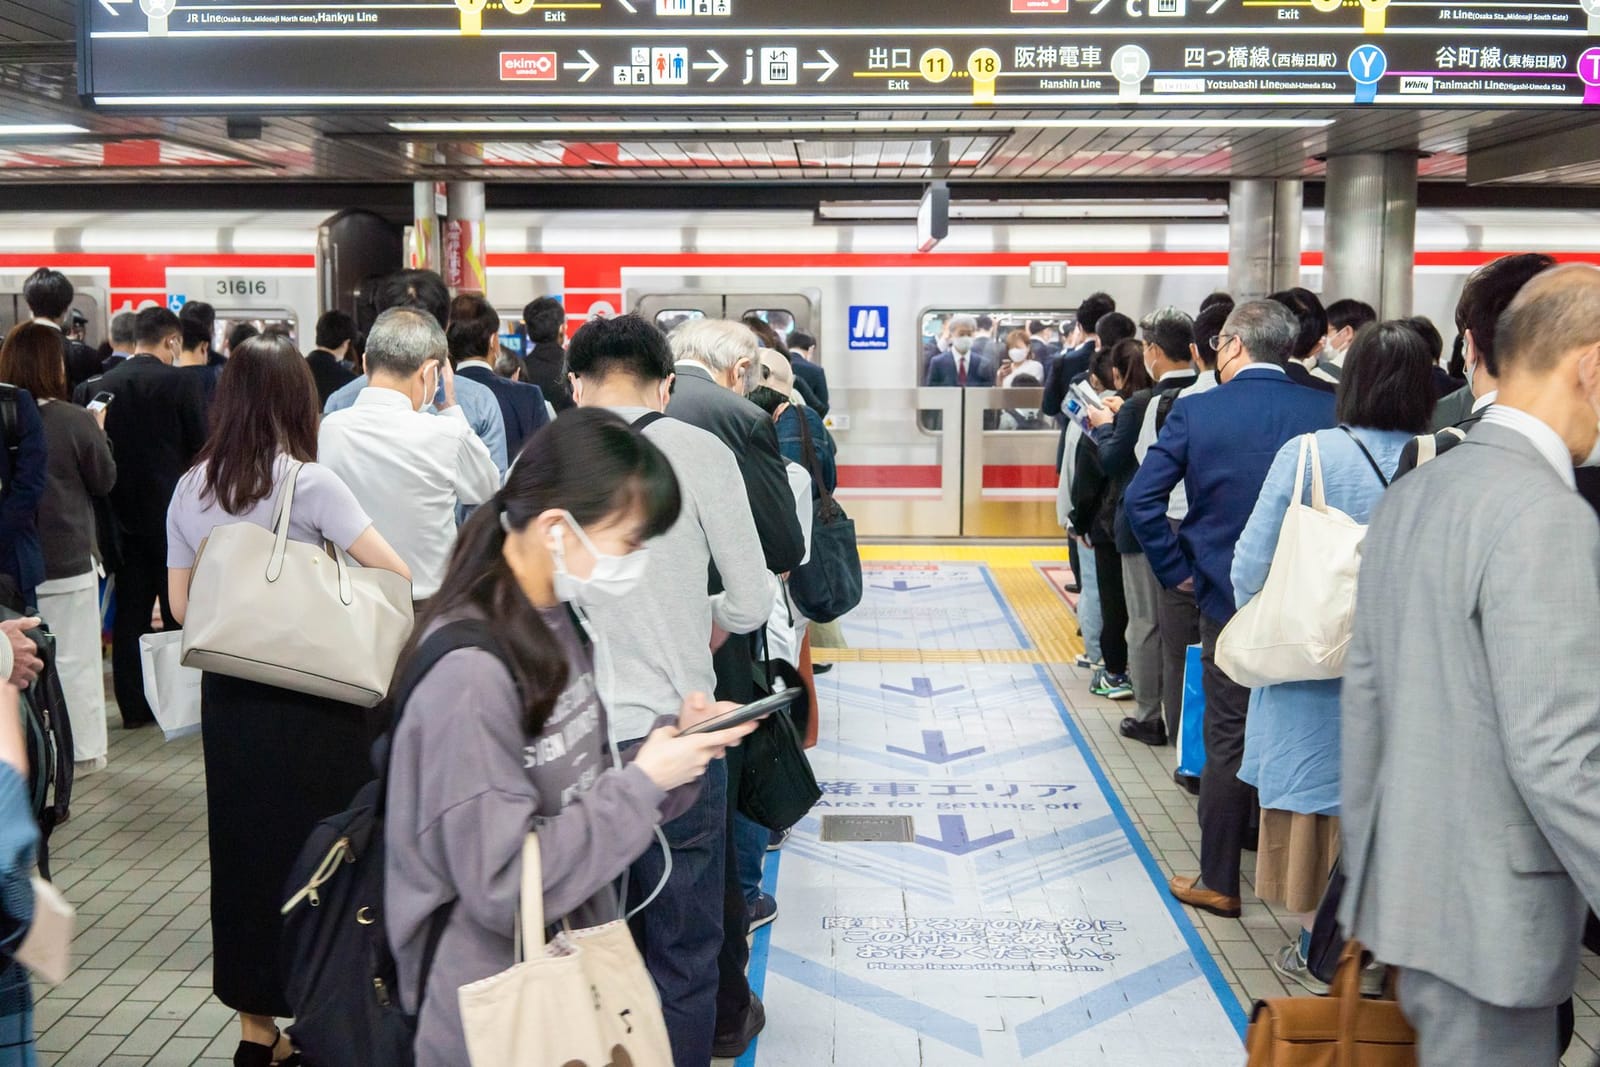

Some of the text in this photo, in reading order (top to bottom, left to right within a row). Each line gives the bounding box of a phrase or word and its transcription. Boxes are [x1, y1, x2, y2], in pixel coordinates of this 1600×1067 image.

[186, 13, 199, 23] JR
[280, 15, 299, 23] North
[356, 12, 378, 22] Line
[544, 11, 567, 22] Exit
[1277, 9, 1299, 20] Exit
[1438, 9, 1451, 19] JR
[1534, 13, 1551, 21] South
[868, 47, 911, 69] 出口
[1014, 46, 1102, 68] 阪神電車
[926, 58, 945, 73] 11
[974, 58, 994, 73] 18
[1358, 51, 1377, 78] Y
[887, 79, 909, 90] Exit
[1040, 79, 1101, 89] Hanshin Line
[1206, 79, 1258, 90] Yotsubashi
[1404, 80, 1429, 91] Whity
[1434, 79, 1482, 90] Tanimachi
[216, 280, 266, 295] 31616
[816, 800, 1082, 812] Area for getting off
[822, 916, 1127, 932] 降車する方のために
[842, 930, 1112, 946] この付近をあけて
[856, 945, 1116, 961] お待ちください。
[866, 961, 1105, 973] Please leave this area open.
